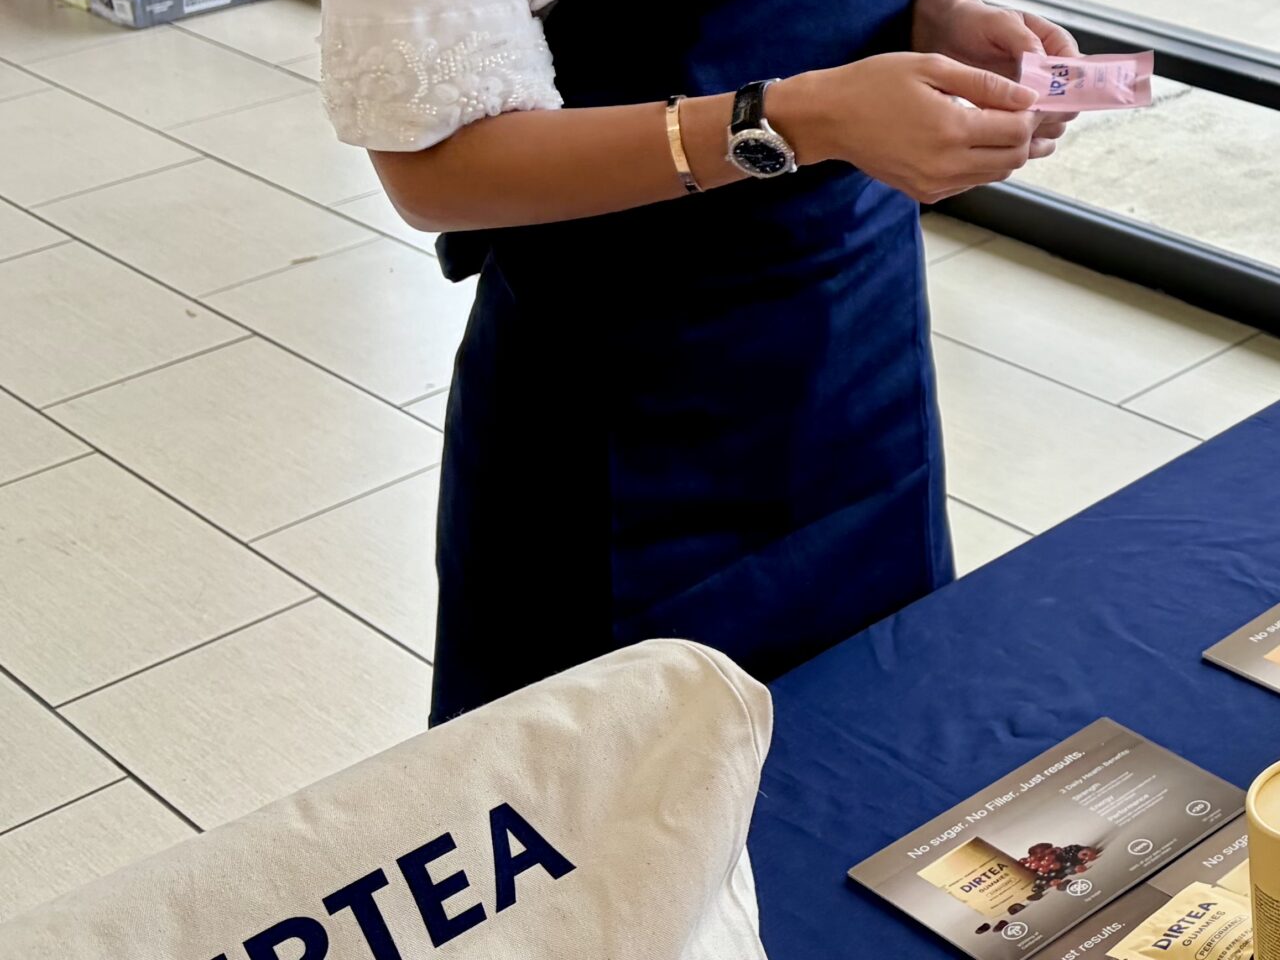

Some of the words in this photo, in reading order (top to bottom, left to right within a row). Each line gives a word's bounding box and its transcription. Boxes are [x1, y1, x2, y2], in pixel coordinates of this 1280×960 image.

[1249, 631, 1268, 643] No
[1064, 778, 1083, 791] Daily
[1082, 765, 1104, 782] Health
[907, 843, 930, 859] No
[929, 821, 968, 846] sugar.
[965, 809, 988, 824] No
[985, 790, 1020, 812] Filler.
[1019, 773, 1046, 792] Just
[1043, 750, 1086, 777] results.
[1107, 793, 1150, 822] Performance
[1202, 853, 1224, 869] No
[211, 801, 577, 960] RTEA
[960, 862, 1008, 894] DIRTEA
[978, 872, 1009, 894] GUMMIES
[1078, 920, 1126, 954] results.
[1152, 902, 1218, 951] DIRTEA
[1181, 910, 1226, 947] GUMMIES
